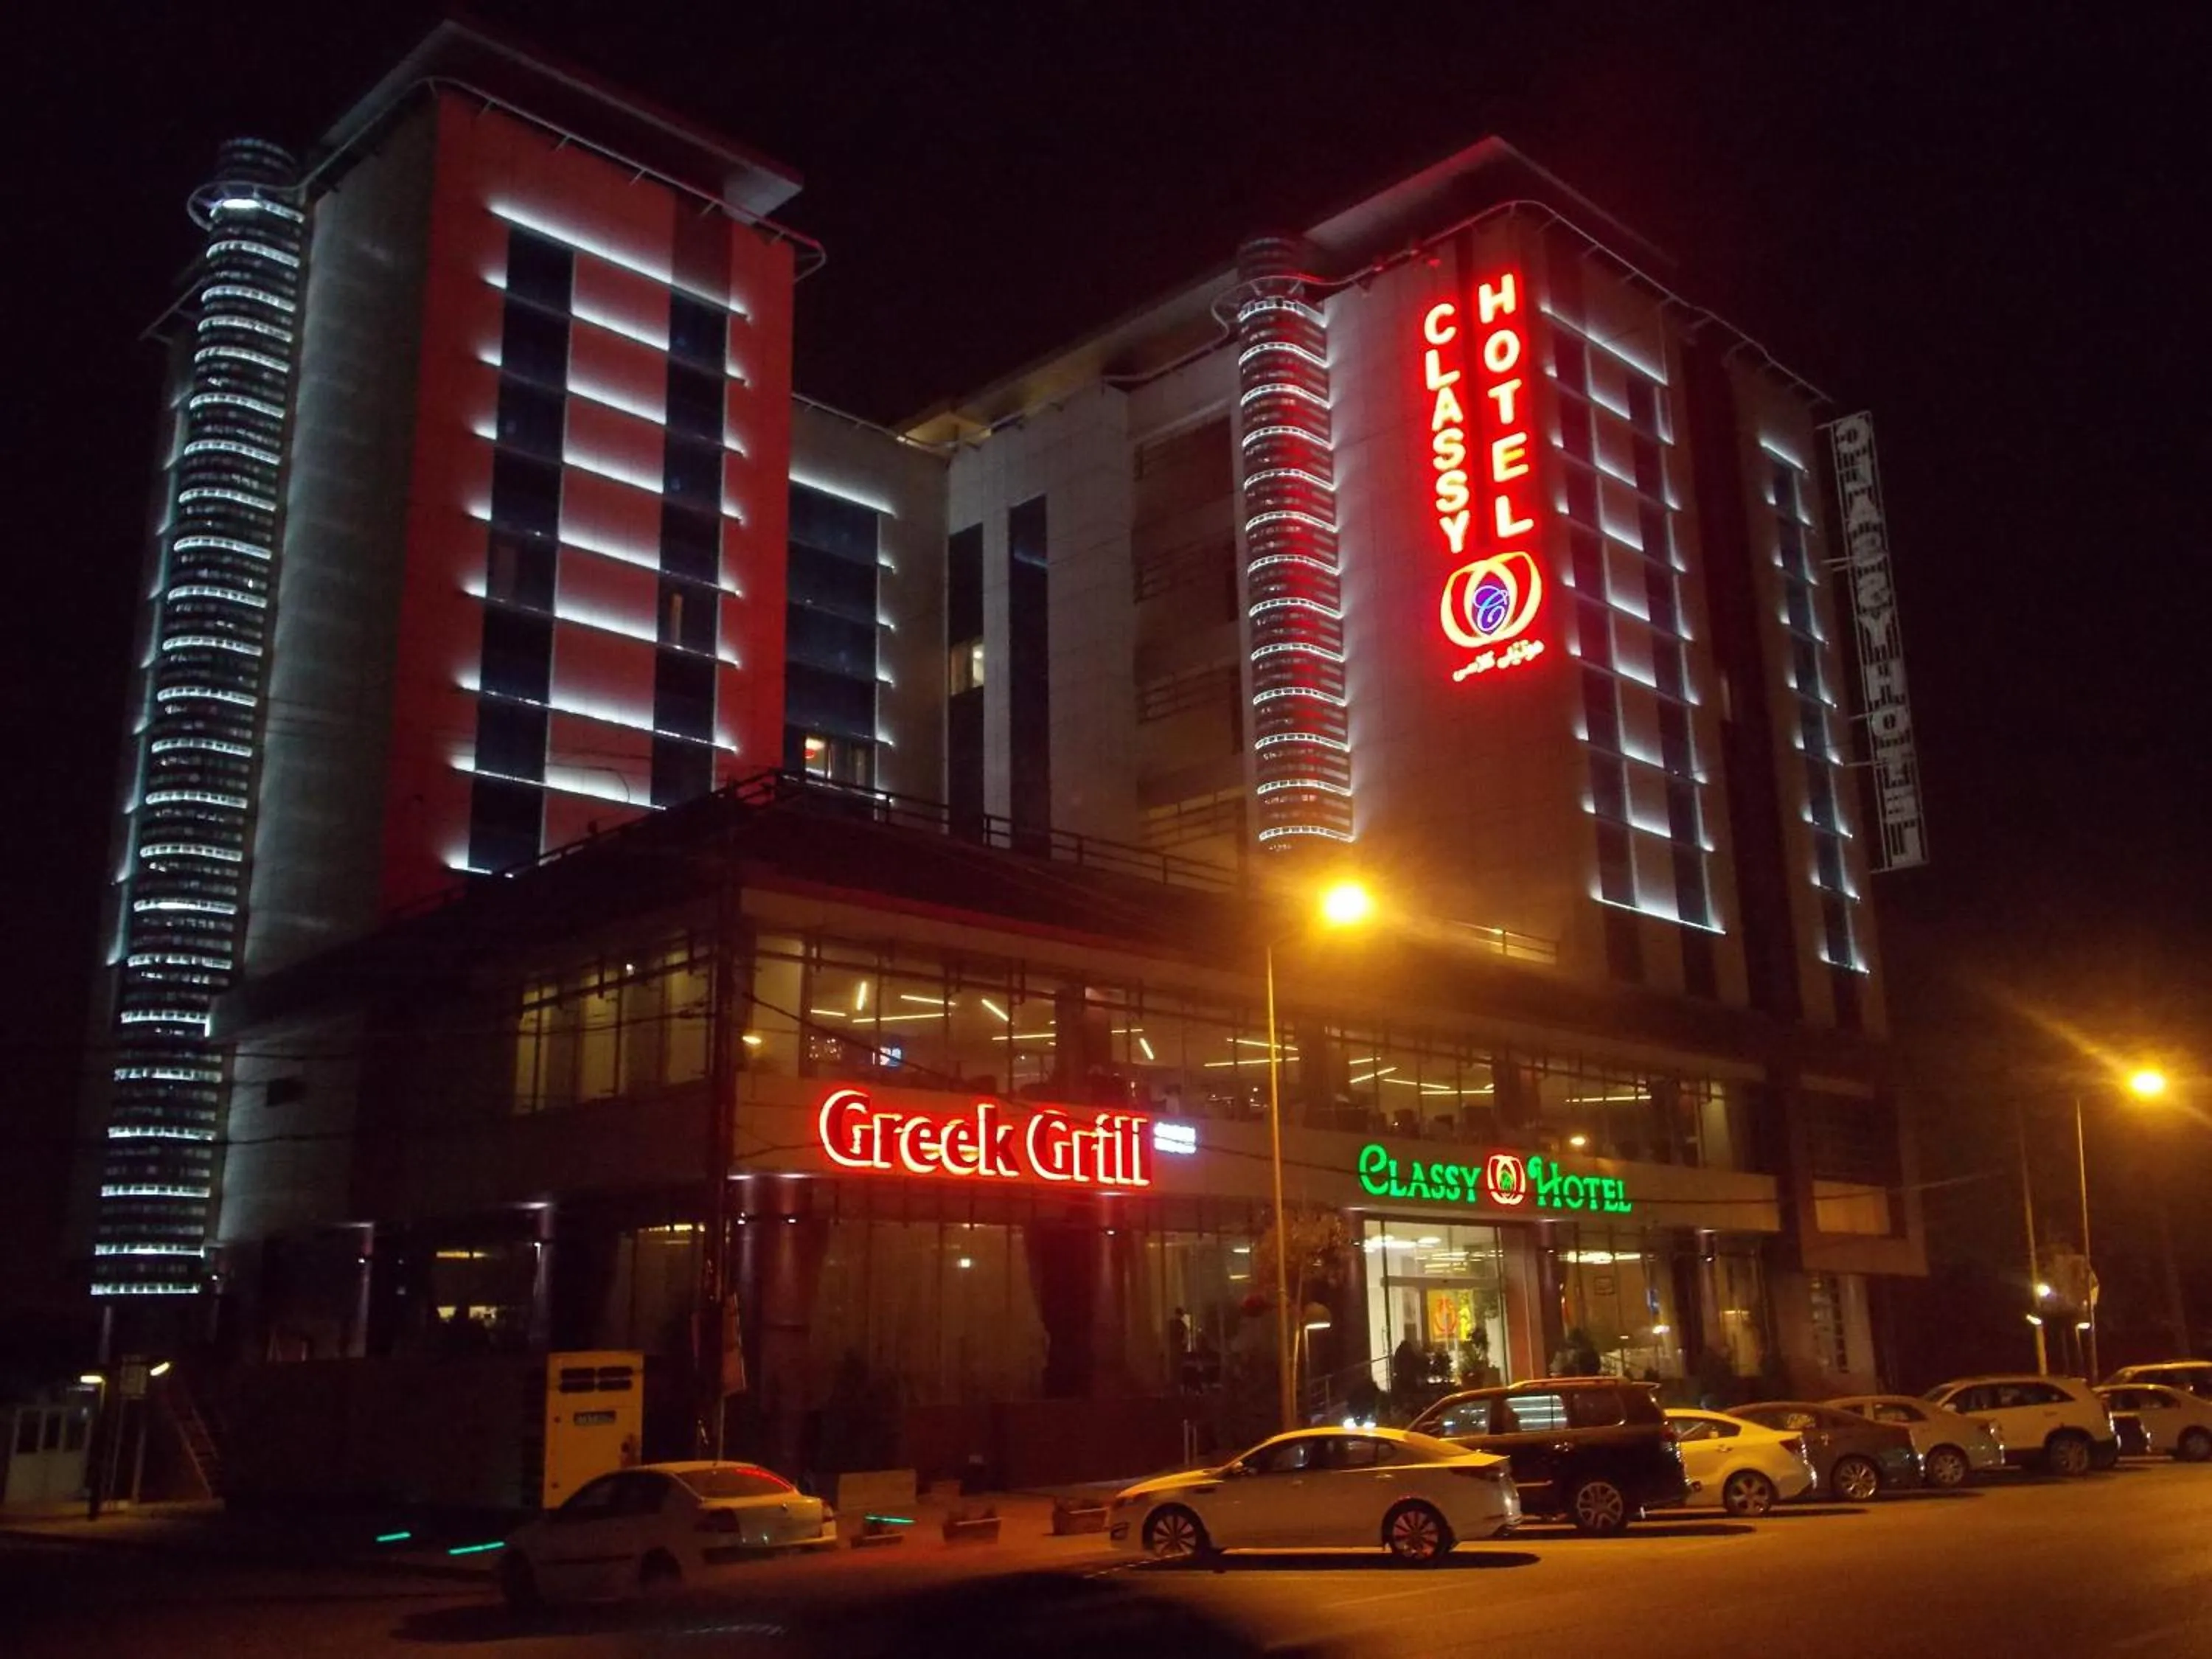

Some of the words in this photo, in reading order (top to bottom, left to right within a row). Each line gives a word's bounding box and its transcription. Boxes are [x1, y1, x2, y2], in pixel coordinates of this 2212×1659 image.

[1424, 303, 1470, 554] CLASSY
[1478, 274, 1534, 538] HOTEL
[819, 1090, 1019, 1176] Greek
[1026, 1110, 1152, 1186] Grill
